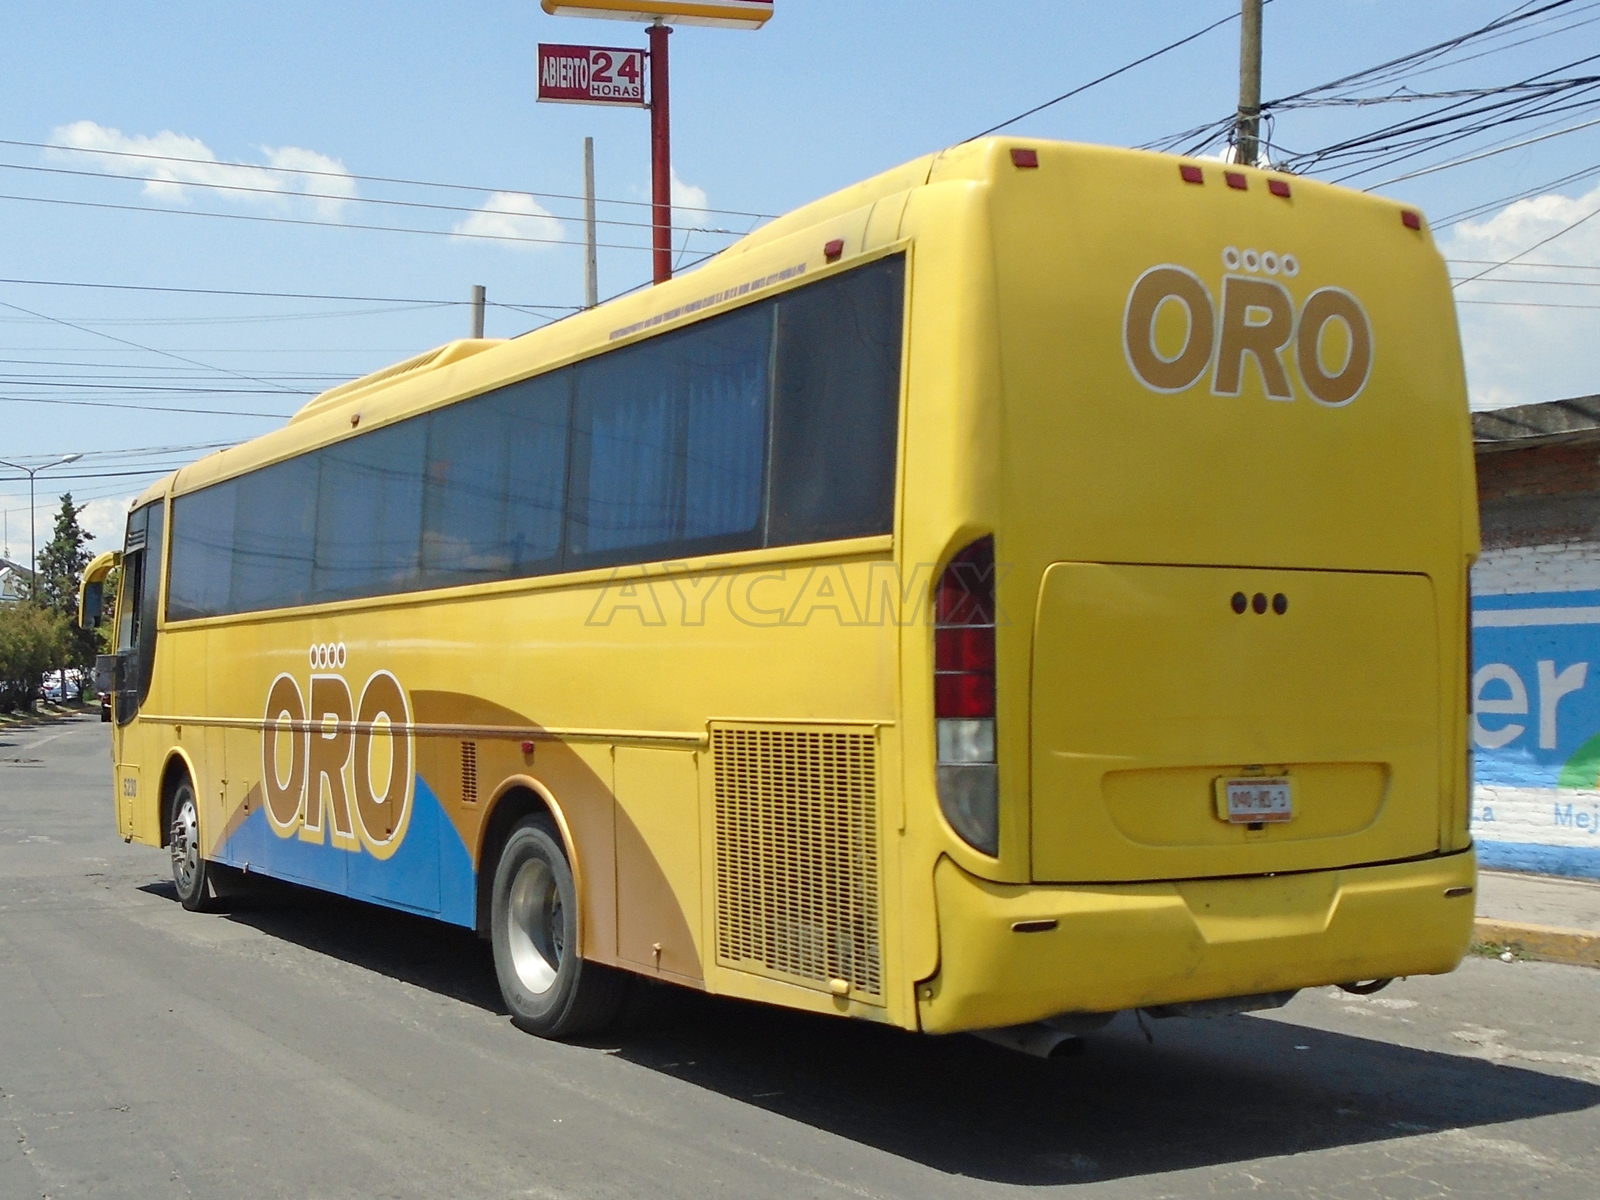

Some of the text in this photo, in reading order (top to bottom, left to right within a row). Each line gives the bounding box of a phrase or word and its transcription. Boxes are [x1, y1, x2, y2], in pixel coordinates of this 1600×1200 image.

[542, 53, 639, 89] ABIERTO 24
[591, 85, 640, 97] HORAS
[1122, 262, 1375, 408] ORO
[261, 668, 413, 847] ORO
